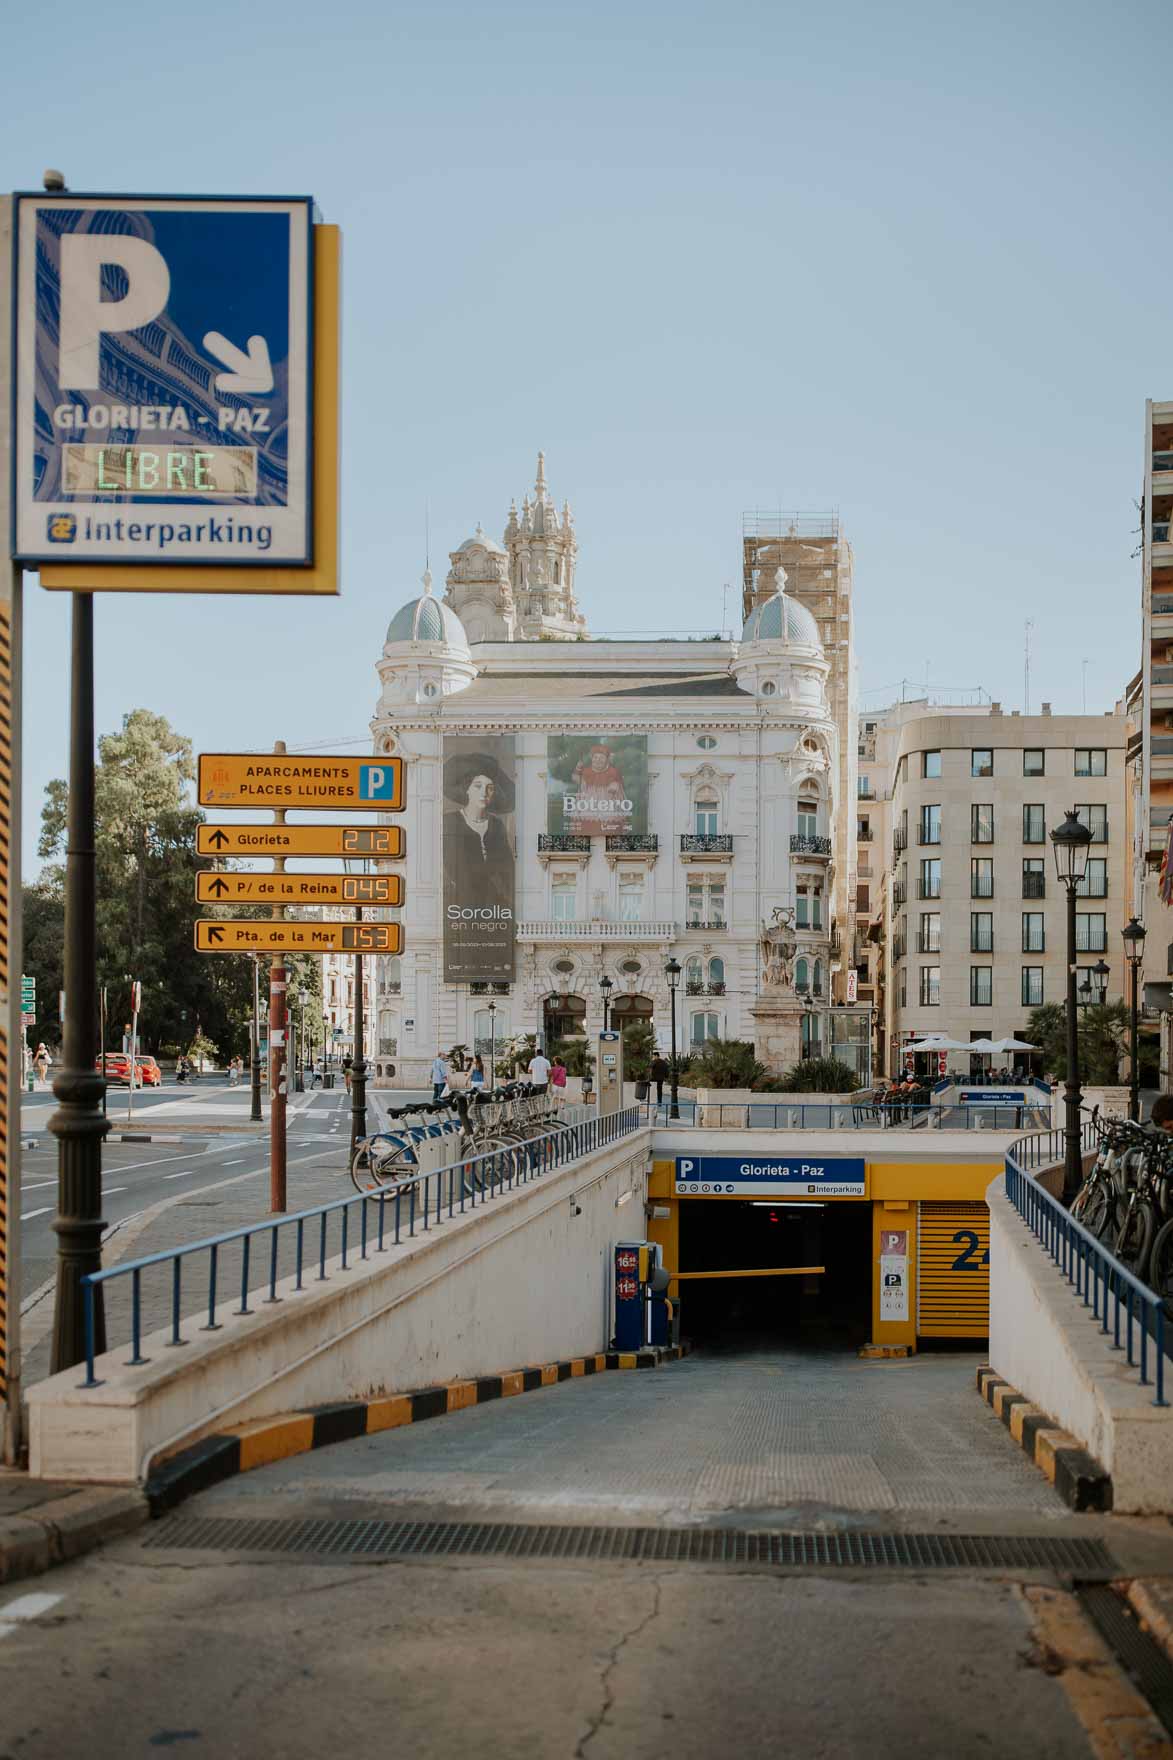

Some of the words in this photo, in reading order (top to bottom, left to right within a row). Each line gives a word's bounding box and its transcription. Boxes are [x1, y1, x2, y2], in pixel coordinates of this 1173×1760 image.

[59, 233, 170, 390] P
[53, 404, 190, 431] GLORIETA
[197, 416, 210, 425] -
[218, 408, 270, 432] PAZ
[97, 450, 216, 490] LIBRE
[85, 517, 273, 550] Interparking
[246, 767, 350, 778] APARCAMENTS
[368, 767, 385, 798] P
[240, 785, 292, 796] PLACES
[298, 786, 355, 797] LLIURES
[563, 797, 633, 811] Botero
[238, 834, 290, 845] Glorieta
[237, 883, 253, 894] P/
[258, 883, 275, 893] de
[281, 883, 294, 893] la
[300, 883, 338, 894] Reina
[343, 879, 389, 900] 045
[447, 905, 513, 919] Sorolla
[451, 922, 467, 930] en
[471, 922, 507, 932] negro
[236, 931, 263, 942] Pta.
[269, 931, 285, 942] de
[291, 931, 305, 942] la
[312, 932, 336, 943] Mar
[352, 927, 389, 948] 153
[680, 1160, 694, 1178] P
[740, 1165, 790, 1176] Glorieta
[801, 1165, 824, 1176] Paz
[816, 1186, 862, 1194] Interparking
[888, 1235, 899, 1248] P
[889, 1275, 896, 1285] P
